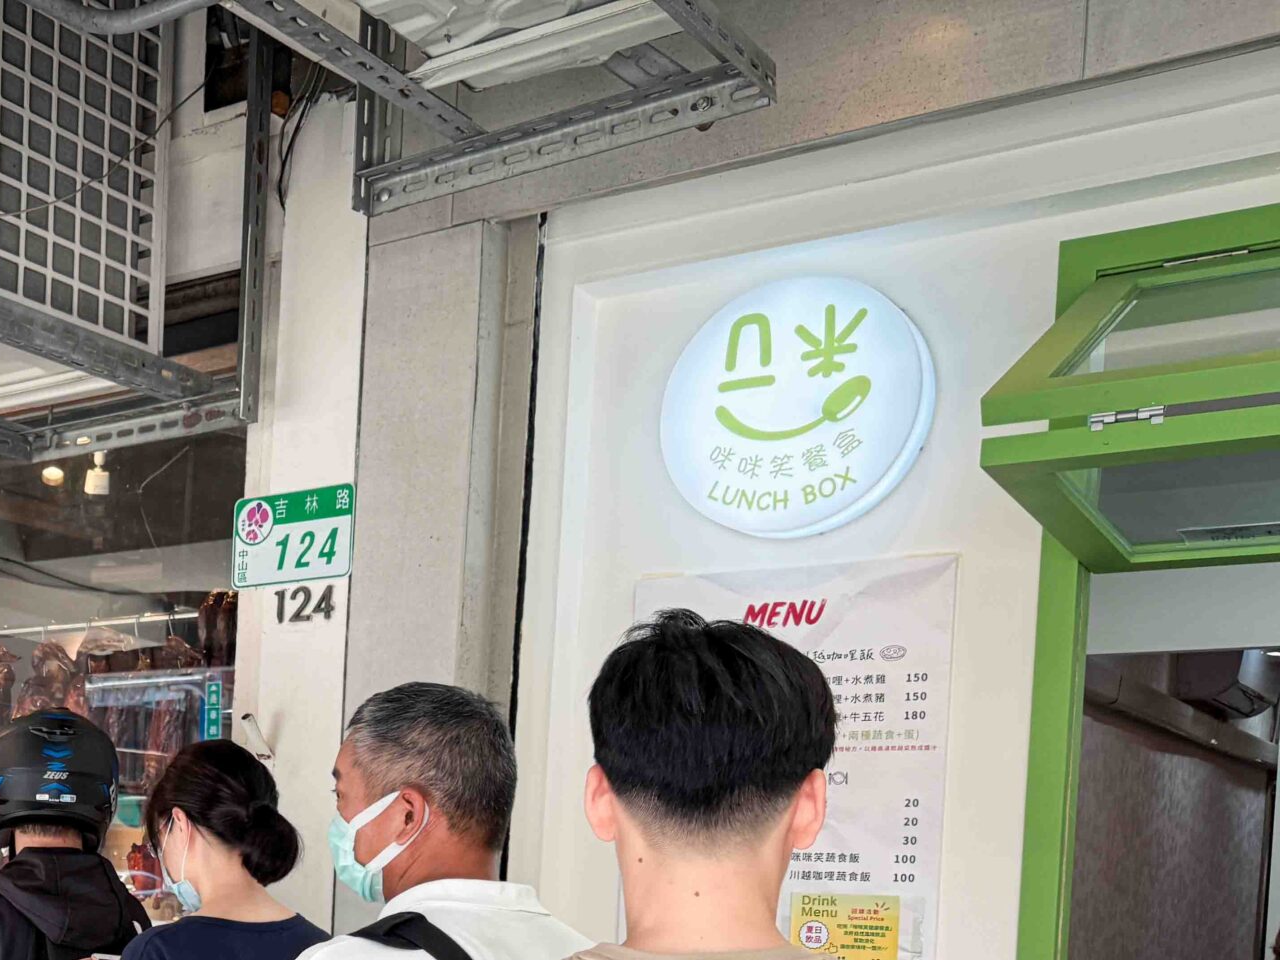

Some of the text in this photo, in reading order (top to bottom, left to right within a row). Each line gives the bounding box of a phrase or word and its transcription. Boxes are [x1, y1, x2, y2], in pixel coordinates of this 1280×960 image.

[707, 466, 857, 511] LUNCH BOX
[274, 488, 350, 519] 吉林路
[275, 527, 339, 571] 124
[237, 549, 249, 584] 中山區
[274, 584, 335, 624] 124
[743, 599, 828, 628] MENU
[905, 673, 928, 683] 150
[904, 692, 927, 702] 150
[903, 711, 926, 720] 180
[42, 770, 69, 780] ZEUS
[904, 798, 919, 808] 20
[903, 817, 918, 827] 20
[902, 836, 917, 846] 30
[894, 855, 916, 864] 100
[892, 873, 915, 883] 100
[801, 895, 838, 907] Drink
[801, 907, 838, 918] Menu
